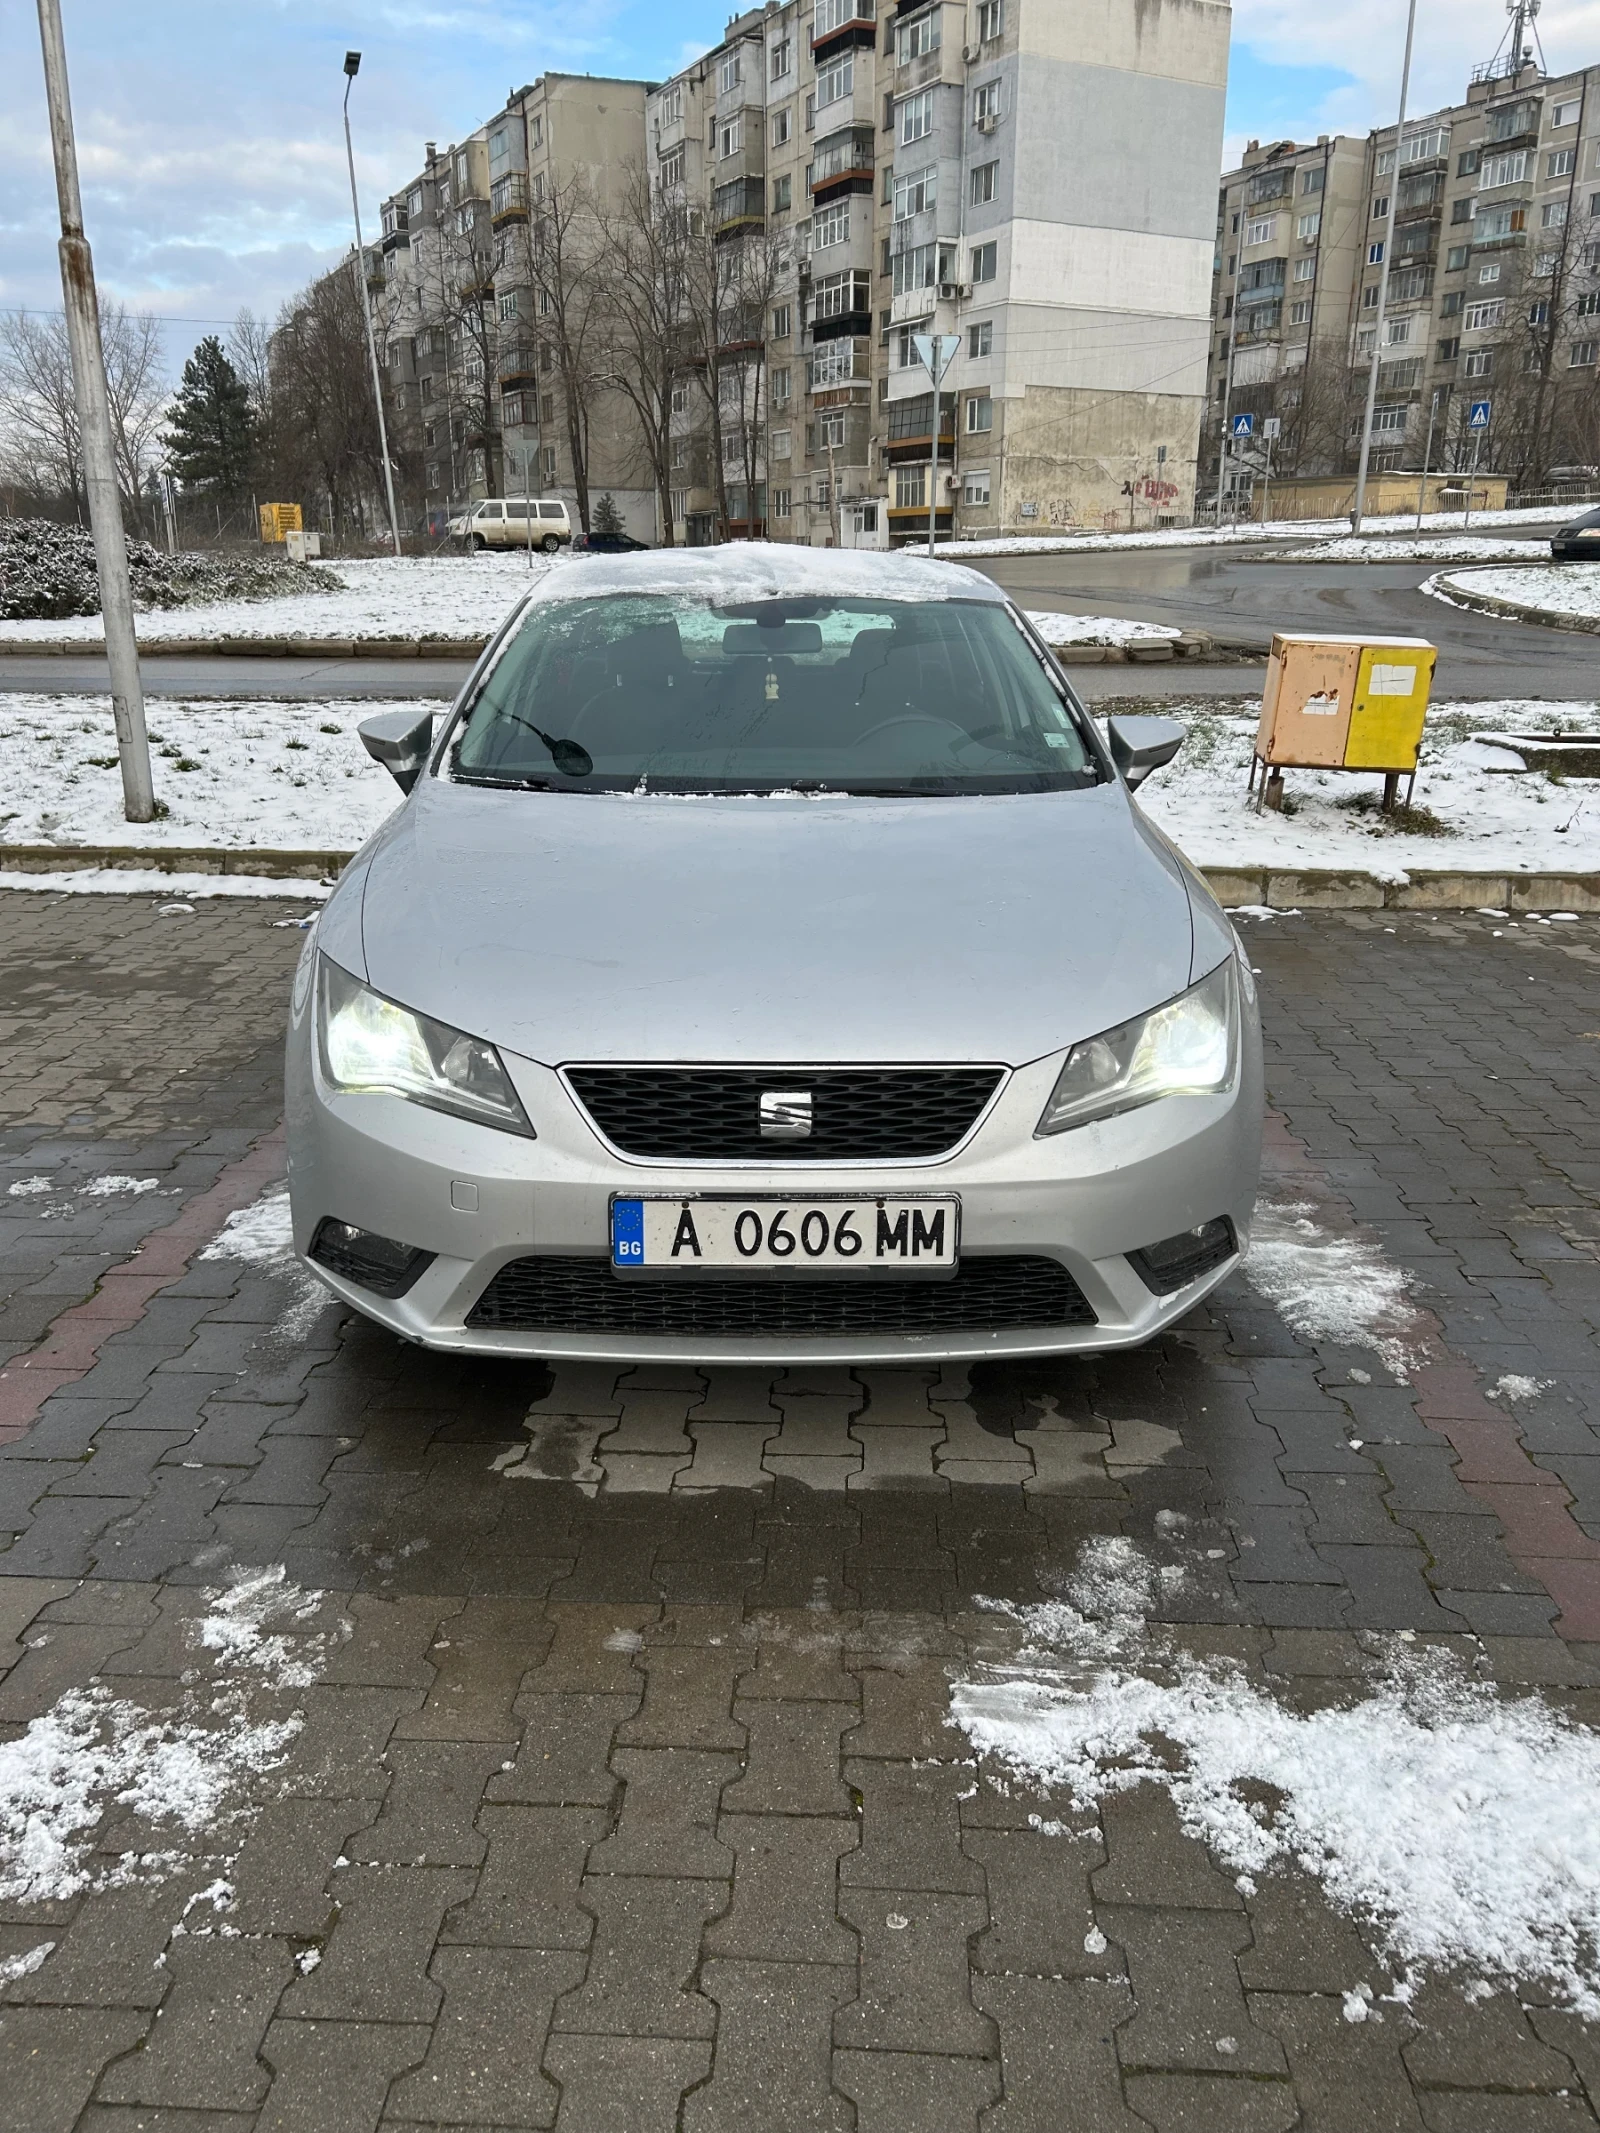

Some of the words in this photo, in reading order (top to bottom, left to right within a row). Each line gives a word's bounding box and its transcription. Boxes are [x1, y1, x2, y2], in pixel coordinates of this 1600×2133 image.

[671, 1209, 702, 1256] A
[734, 1210, 862, 1256] 0606
[876, 1209, 945, 1256] MM
[619, 1241, 641, 1256] BG
